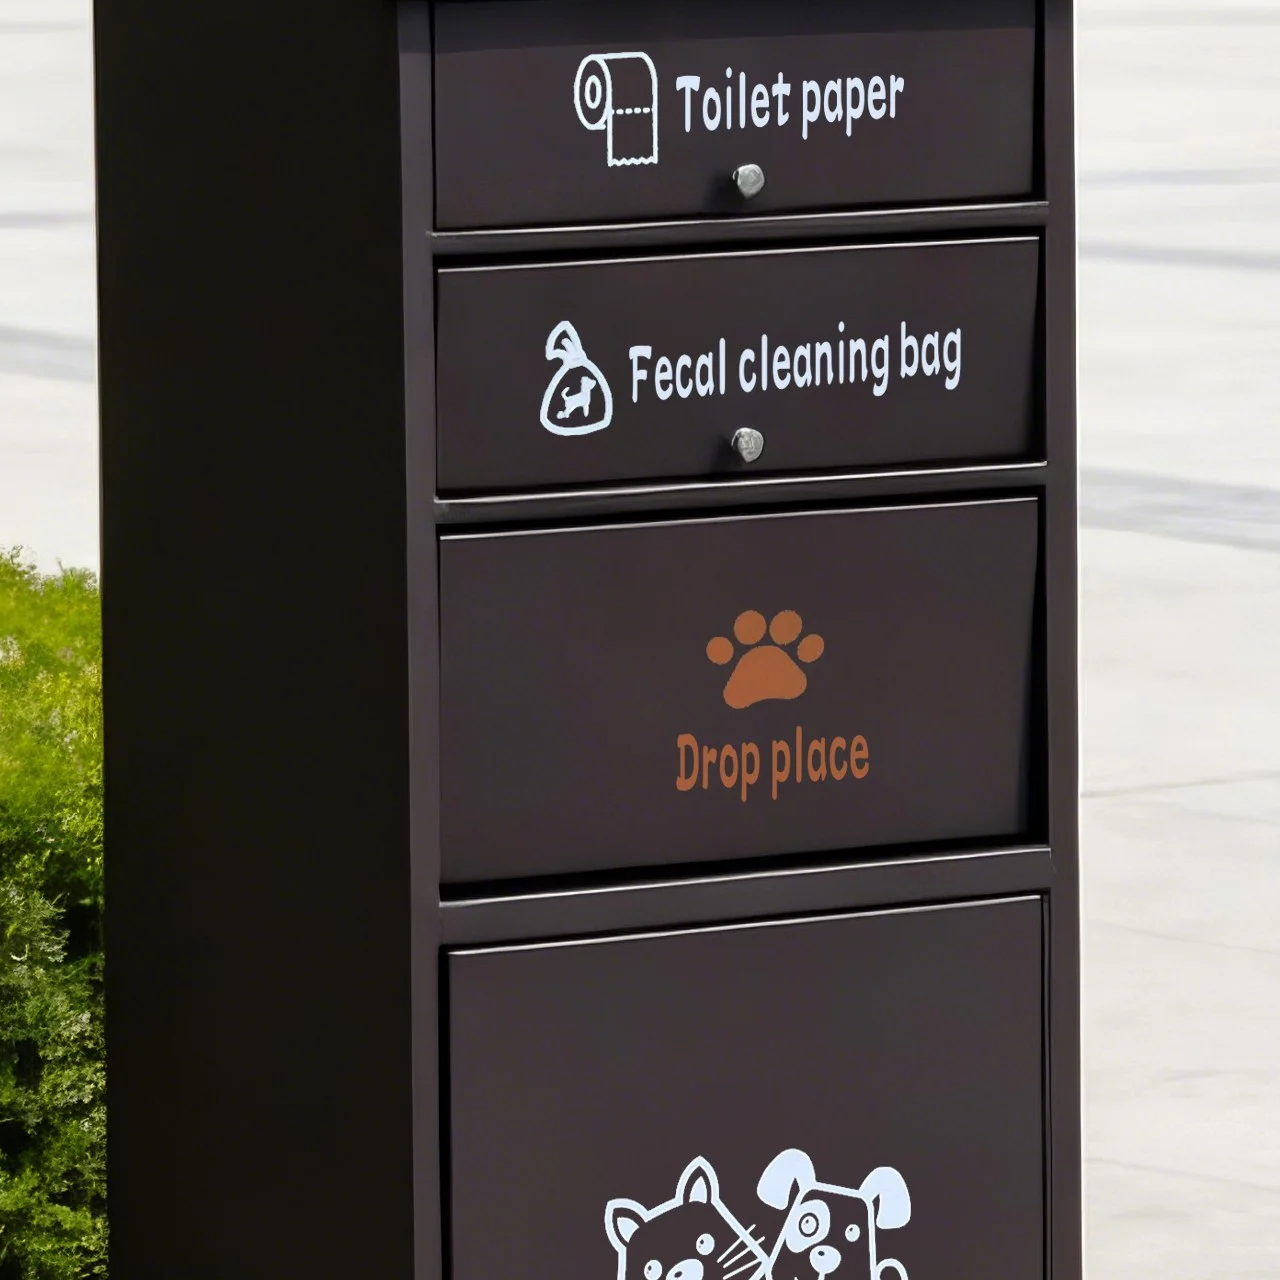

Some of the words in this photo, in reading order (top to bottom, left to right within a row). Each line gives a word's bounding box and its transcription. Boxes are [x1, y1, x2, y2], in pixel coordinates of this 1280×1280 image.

[675, 66, 792, 133] Toilet
[801, 74, 905, 141] paper
[628, 337, 726, 404] Fecal
[738, 320, 890, 397] cleaning
[899, 320, 962, 391] bag
[675, 732, 761, 803] Drop
[771, 725, 870, 800] place
